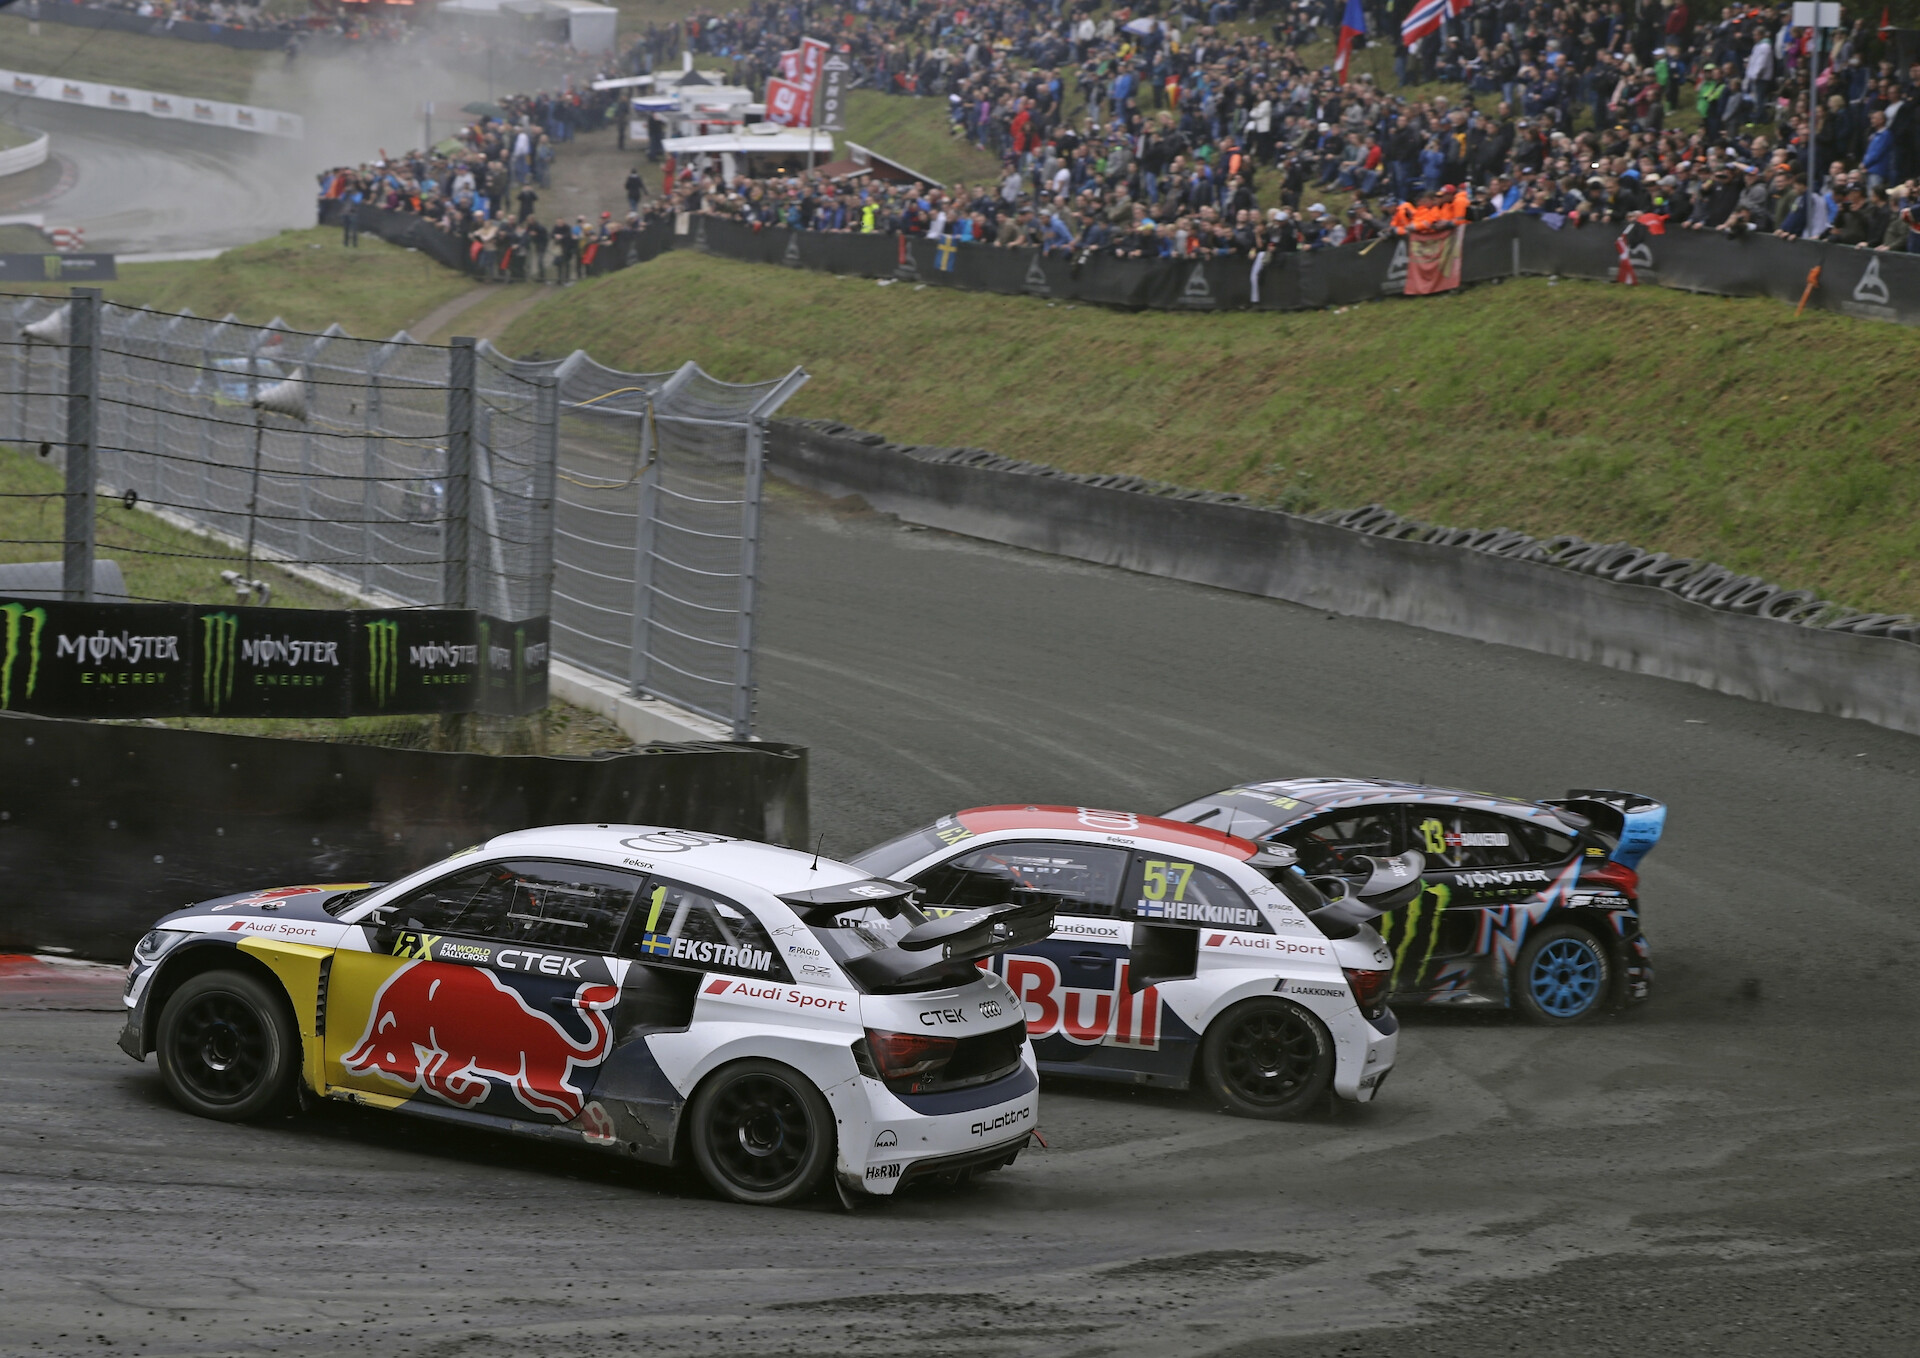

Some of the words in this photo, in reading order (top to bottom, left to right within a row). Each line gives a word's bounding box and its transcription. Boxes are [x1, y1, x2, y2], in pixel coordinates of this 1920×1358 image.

[56, 629, 180, 665] MONSTER
[241, 634, 339, 667] MONSTER
[81, 672, 166, 684] ENERGY
[254, 674, 324, 686] ENERGY
[1420, 819, 1446, 854] 13
[623, 857, 655, 870] #eksrx
[1143, 860, 1195, 901] 57
[1454, 869, 1552, 888] MONSTER
[645, 885, 667, 932] 1
[1163, 901, 1259, 927] HEIKKINEN
[245, 922, 277, 932] Audi
[278, 924, 318, 936] Sport
[1055, 924, 1118, 936] CHÖNOX
[439, 949, 489, 962] RALLYCROSS
[673, 937, 773, 972] EKSTRÖM
[796, 946, 820, 957] PAGID
[1229, 936, 1270, 949] Audi
[1275, 940, 1327, 956] Sport
[496, 949, 587, 978] CTEK
[802, 964, 831, 974] OZ
[732, 983, 783, 1000] Audi
[786, 991, 848, 1012] Sport
[1291, 986, 1346, 998] LAAKKONEN
[1006, 958, 1160, 1046] Bull
[919, 1008, 968, 1026] CTEK
[971, 1107, 1030, 1137] quattro
[876, 1140, 897, 1148] MAN
[866, 1165, 889, 1180] H&R
